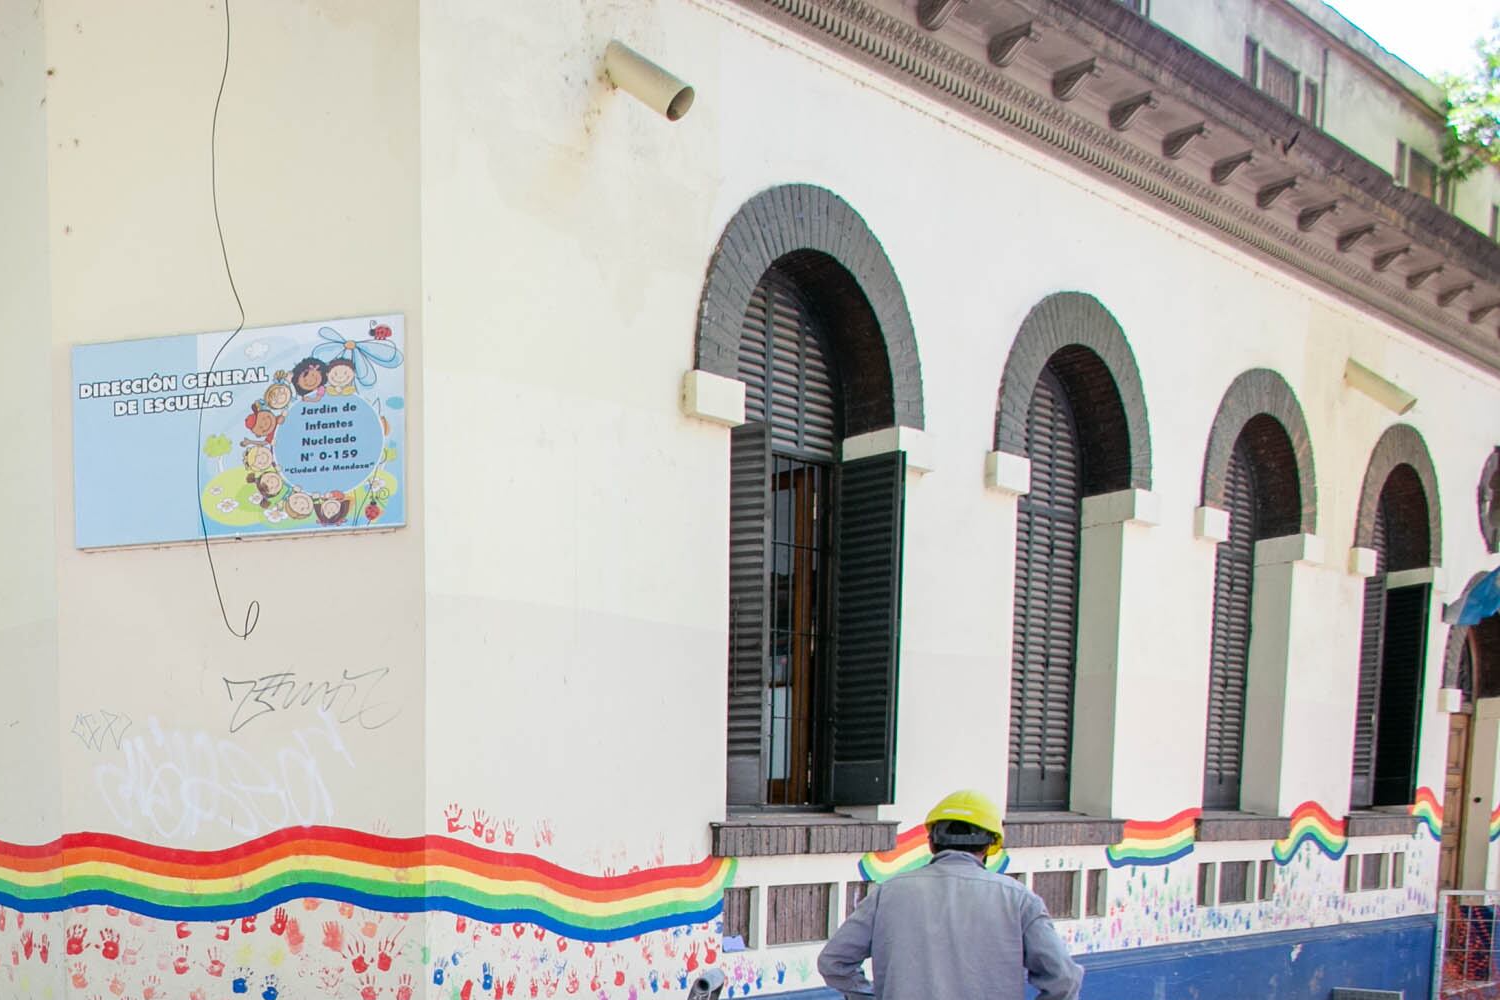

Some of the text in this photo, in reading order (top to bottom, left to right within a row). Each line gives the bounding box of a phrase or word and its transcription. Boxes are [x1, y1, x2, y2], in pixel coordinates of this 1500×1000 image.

[79, 367, 269, 399] DIRECCIÓN GENERAL
[114, 391, 233, 416] DE ESCUELAS
[342, 402, 357, 412] de
[305, 420, 353, 431] Infantes
[301, 433, 357, 446] Nucleado
[319, 449, 358, 460] 0-159
